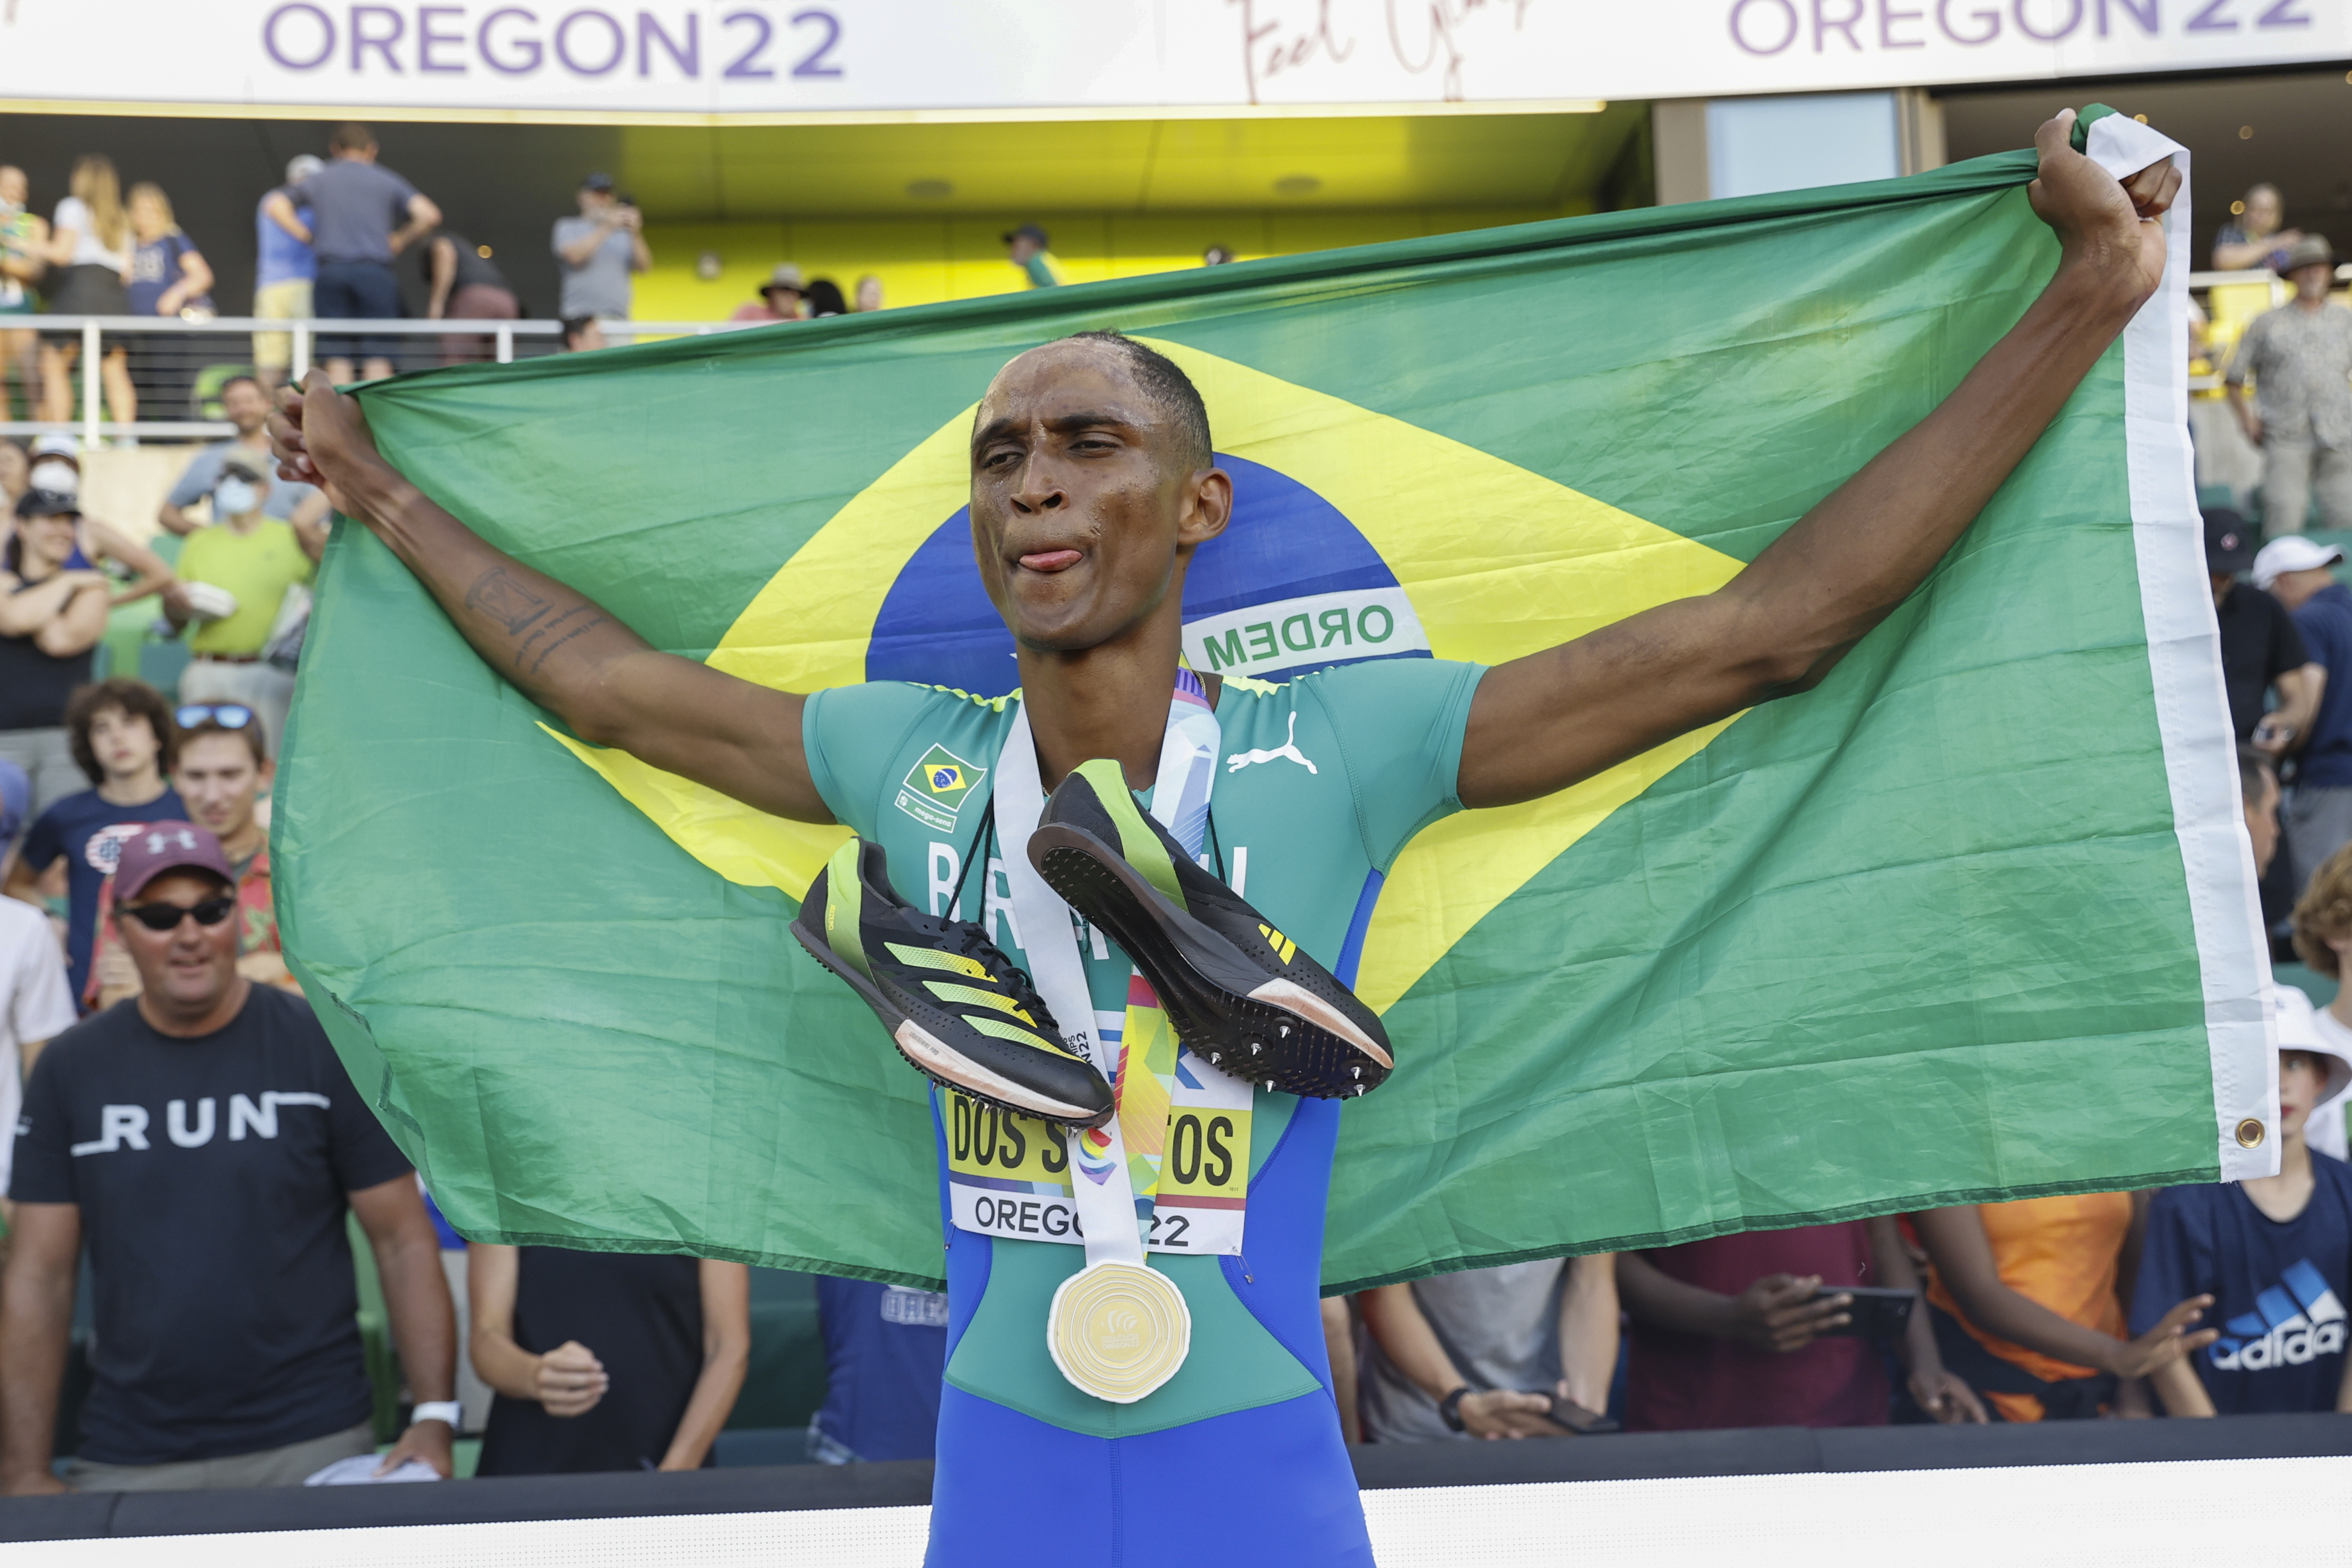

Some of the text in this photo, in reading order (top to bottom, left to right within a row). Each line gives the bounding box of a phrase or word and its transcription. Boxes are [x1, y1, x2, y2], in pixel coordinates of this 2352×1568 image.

[264, 2, 845, 80] OREGON22
[914, 807, 952, 827] mega-sena
[828, 904, 836, 930] ADIZERO
[929, 1046, 939, 1055] PRO
[71, 1090, 330, 1157] RUN
[954, 1094, 1026, 1169] DOS
[2208, 1321, 2349, 1371] adida
